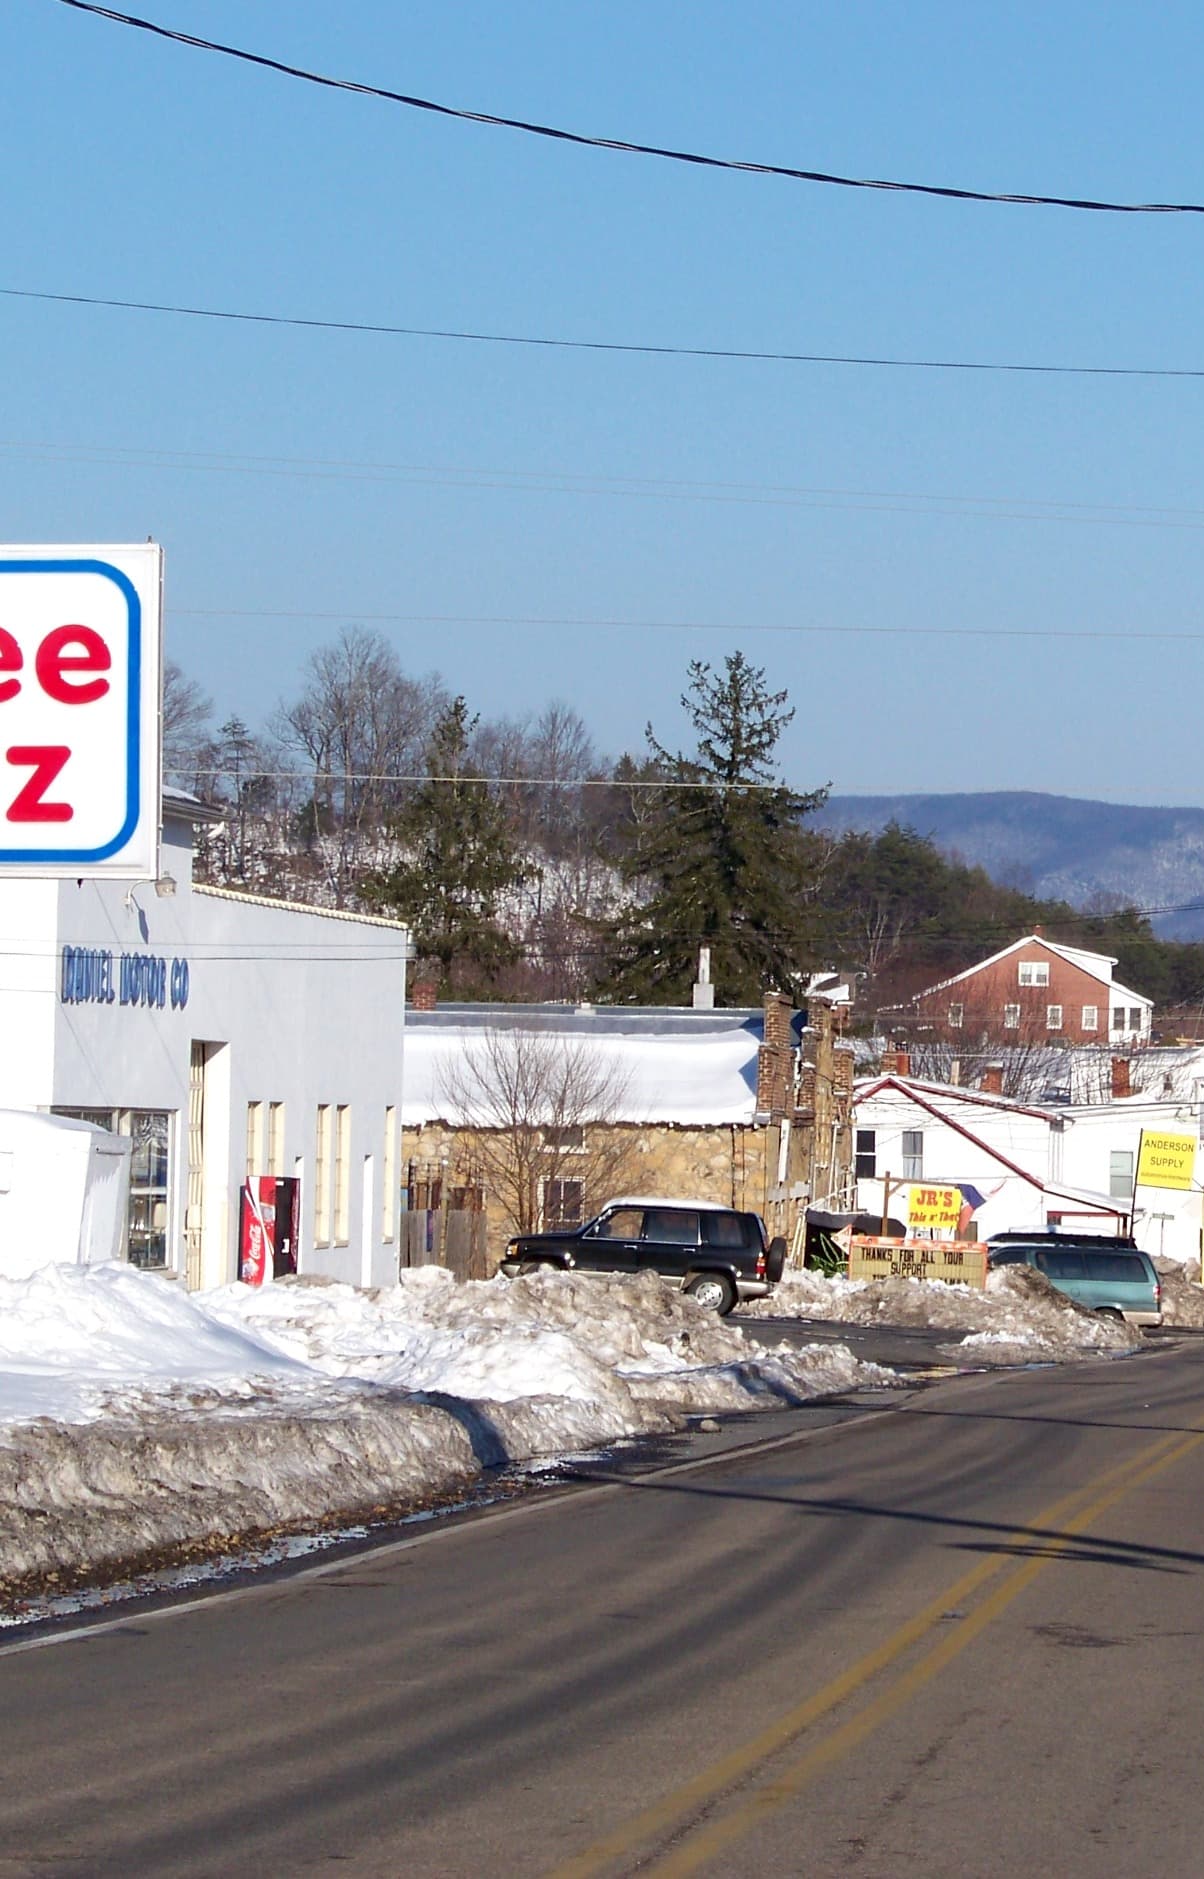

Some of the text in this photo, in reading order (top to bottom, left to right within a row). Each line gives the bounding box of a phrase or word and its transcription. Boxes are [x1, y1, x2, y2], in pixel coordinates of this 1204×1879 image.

[171, 957, 189, 1011] CO
[1144, 1139, 1195, 1153] ANDERSON
[1150, 1156, 1184, 1169] SUPPLY
[917, 1189, 953, 1208] JR'S
[909, 1212, 926, 1223] This
[861, 1248, 964, 1265] THANKS FOR ALL YOUR
[890, 1262, 927, 1276] SUPPORT
